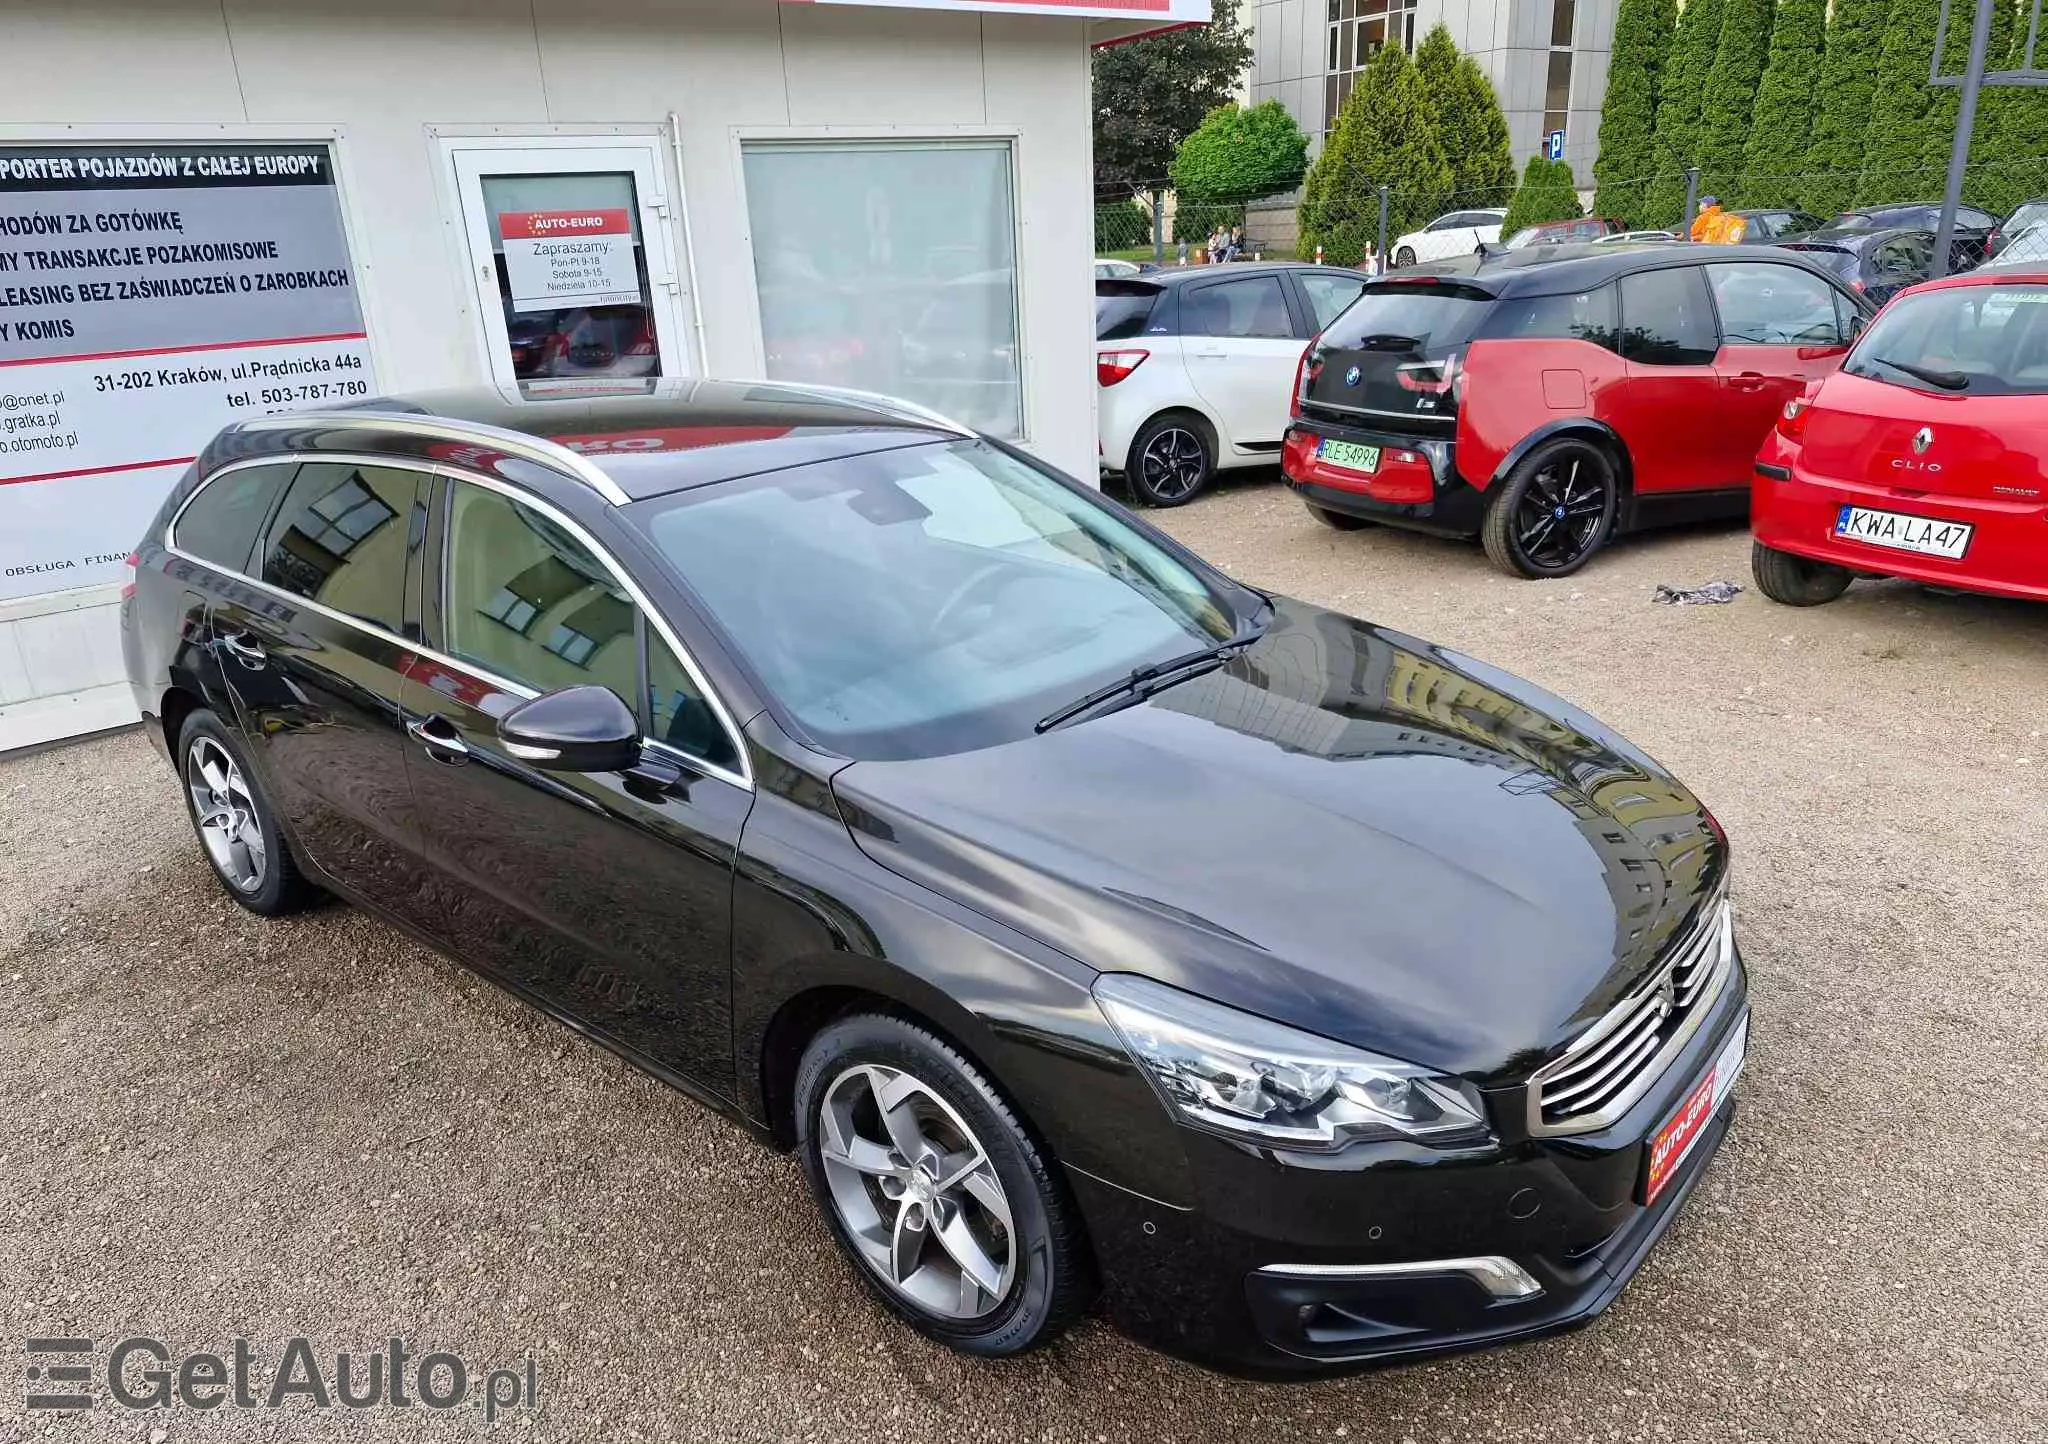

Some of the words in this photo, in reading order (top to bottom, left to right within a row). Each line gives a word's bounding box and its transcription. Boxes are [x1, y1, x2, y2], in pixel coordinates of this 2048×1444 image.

[1552, 134, 1561, 159] P
[0, 158, 76, 180] PORTER
[78, 153, 178, 178] POJAZDÓW
[181, 156, 195, 176] Z
[197, 155, 251, 176] CAŁEJ
[254, 155, 319, 175] EUROPY
[66, 214, 92, 233] ZA
[96, 208, 183, 234] GOTÓWKĘ
[535, 217, 603, 229] AUTO-EURO
[24, 247, 143, 270] TRANSAKCJE
[146, 241, 279, 265] POZAKOMISOWE
[78, 283, 114, 302] BEZ
[116, 272, 236, 299] ZAŚWIADCZEŃ
[240, 275, 252, 292] O
[255, 269, 349, 291] ZAROBKACH
[547, 281, 585, 291] Niedziela
[588, 278, 611, 288] 10-15
[552, 269, 582, 279] Sobota
[583, 268, 602, 277] 9-15
[15, 319, 75, 341] KOMIS
[94, 371, 154, 392] 31-202
[157, 366, 227, 386] Kraków,
[231, 357, 330, 379] ul.Prądnicka
[335, 353, 362, 370] 44a
[0, 390, 65, 411] @onet.pl
[227, 392, 256, 408] tel.
[262, 380, 367, 404] 503-787-780
[0, 410, 61, 433] .gratka.pl
[1323, 441, 1343, 460] RLE
[1343, 445, 1377, 467] 54996
[1891, 459, 1942, 472] CLIO
[1851, 511, 1895, 539] KWA
[1903, 520, 1966, 549] LA47
[5, 560, 76, 577] OBSŁUGA
